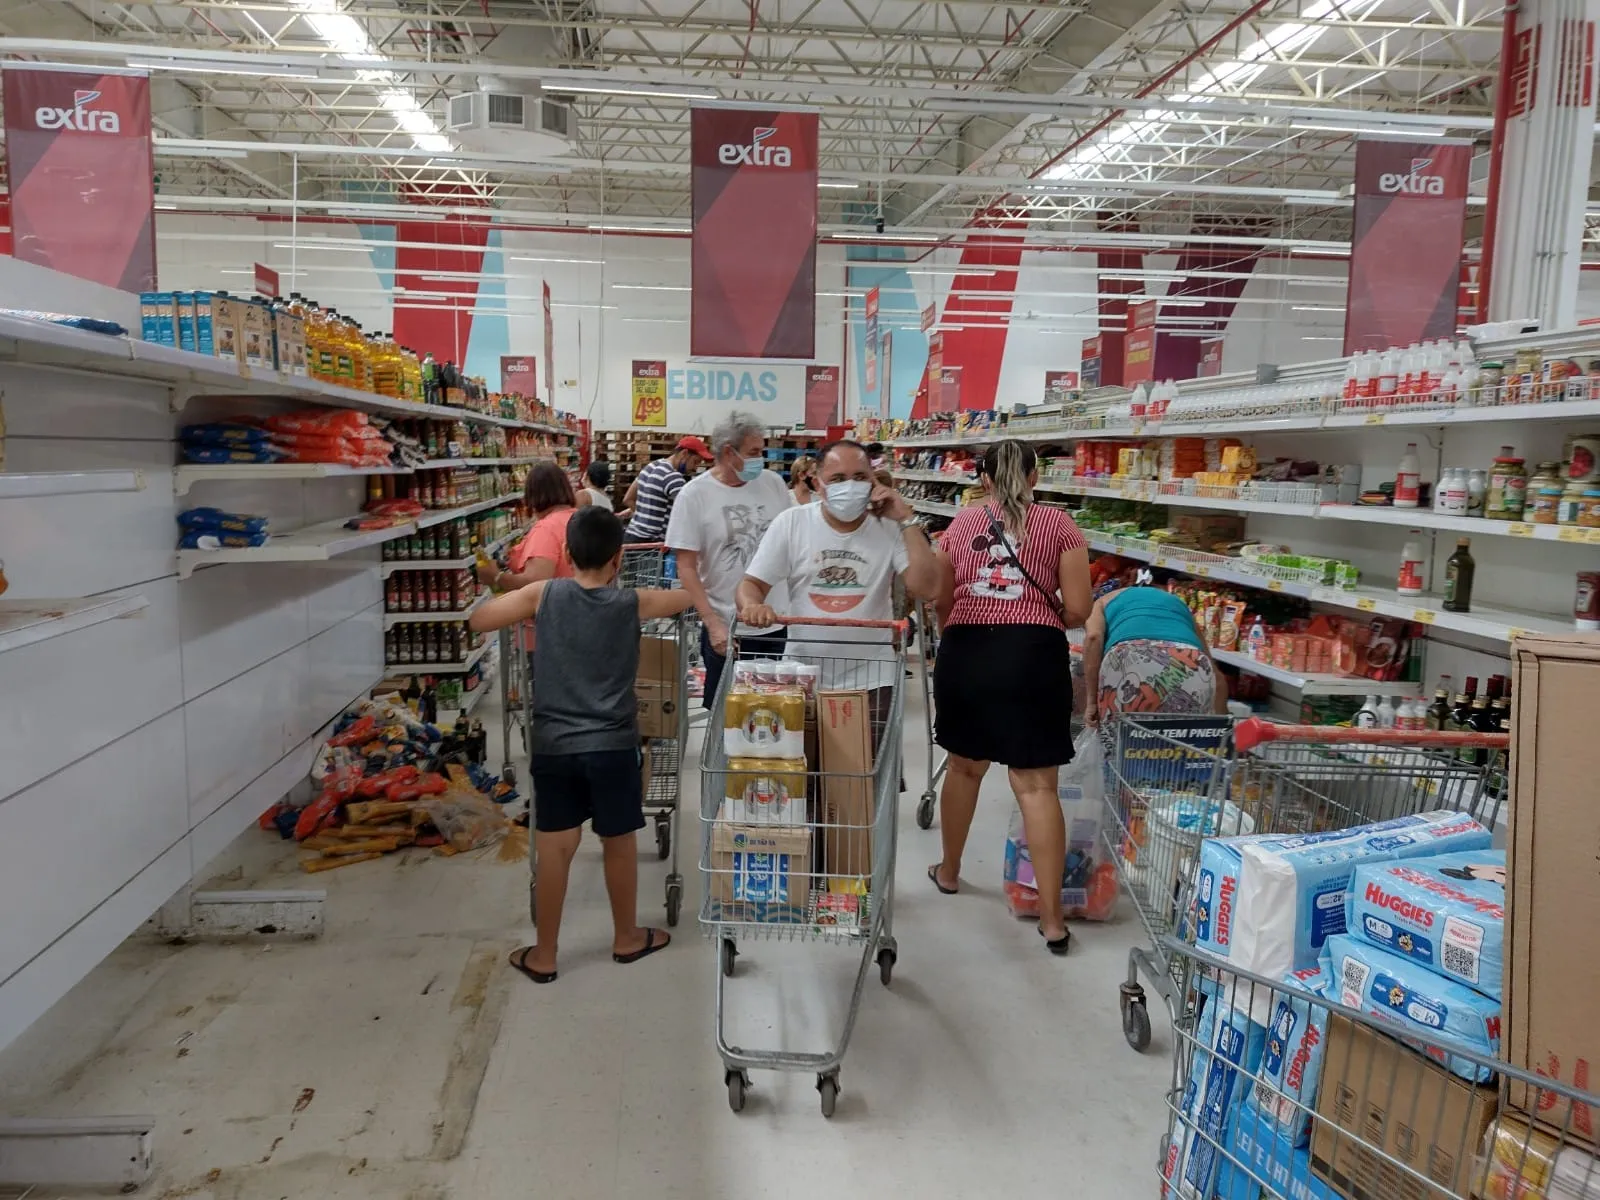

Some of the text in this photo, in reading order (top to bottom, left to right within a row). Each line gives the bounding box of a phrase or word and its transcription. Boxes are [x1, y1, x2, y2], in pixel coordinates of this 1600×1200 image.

[36, 102, 120, 133] extra
[718, 140, 792, 167] extra
[1379, 169, 1445, 195] extra
[507, 363, 529, 372] extra
[638, 368, 660, 376] extra
[812, 372, 833, 381] extra
[668, 369, 777, 402] EBIDAS
[1051, 377, 1073, 387] extra
[1163, 728, 1187, 738] TEM
[1189, 728, 1228, 738] PNEUS
[1216, 875, 1237, 946] HUGGIES
[1364, 881, 1435, 928] HUGGIES
[1368, 919, 1378, 931] M
[1424, 1011, 1436, 1025] M
[1286, 1023, 1321, 1091] HUGGIES
